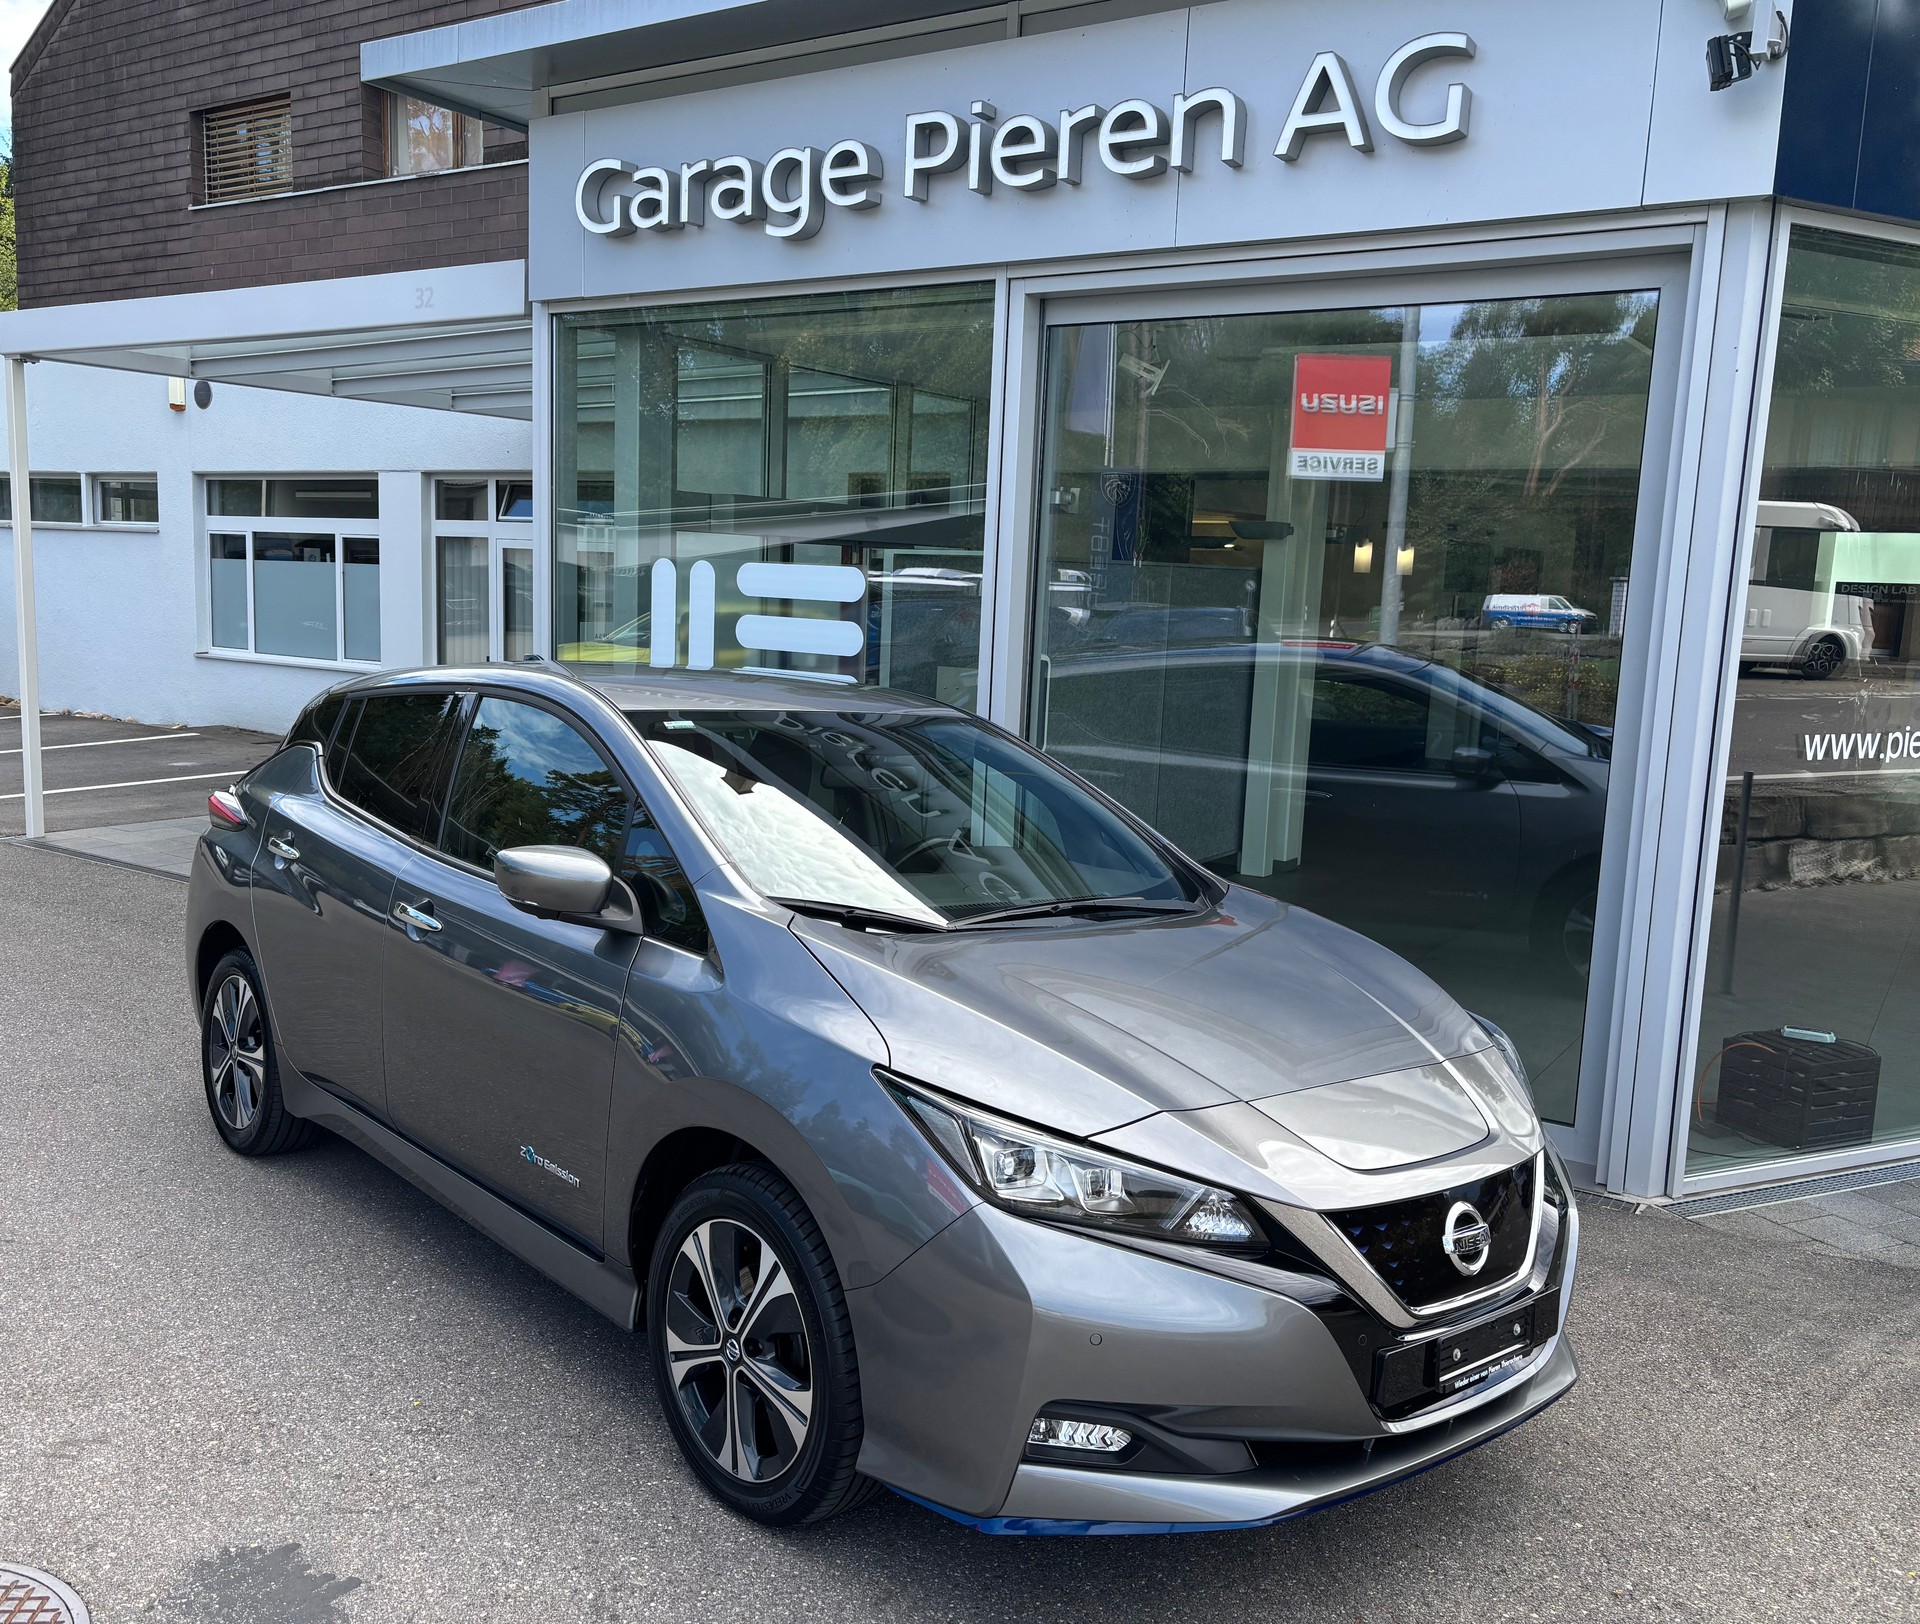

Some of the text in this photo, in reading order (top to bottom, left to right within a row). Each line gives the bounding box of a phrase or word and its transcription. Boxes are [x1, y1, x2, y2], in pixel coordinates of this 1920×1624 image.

[574, 31, 1477, 241] Garage Pieren AG
[414, 286, 435, 309] 32
[1841, 583, 1918, 595] DESIGN LAB
[543, 1159, 581, 1188] Emission
[1454, 1228, 1491, 1253] NISSAN
[1454, 1375, 1470, 1389] Wieder
[1469, 1372, 1480, 1383] einer
[1480, 1369, 1489, 1378] von
[1488, 1364, 1501, 1375] Pieren
